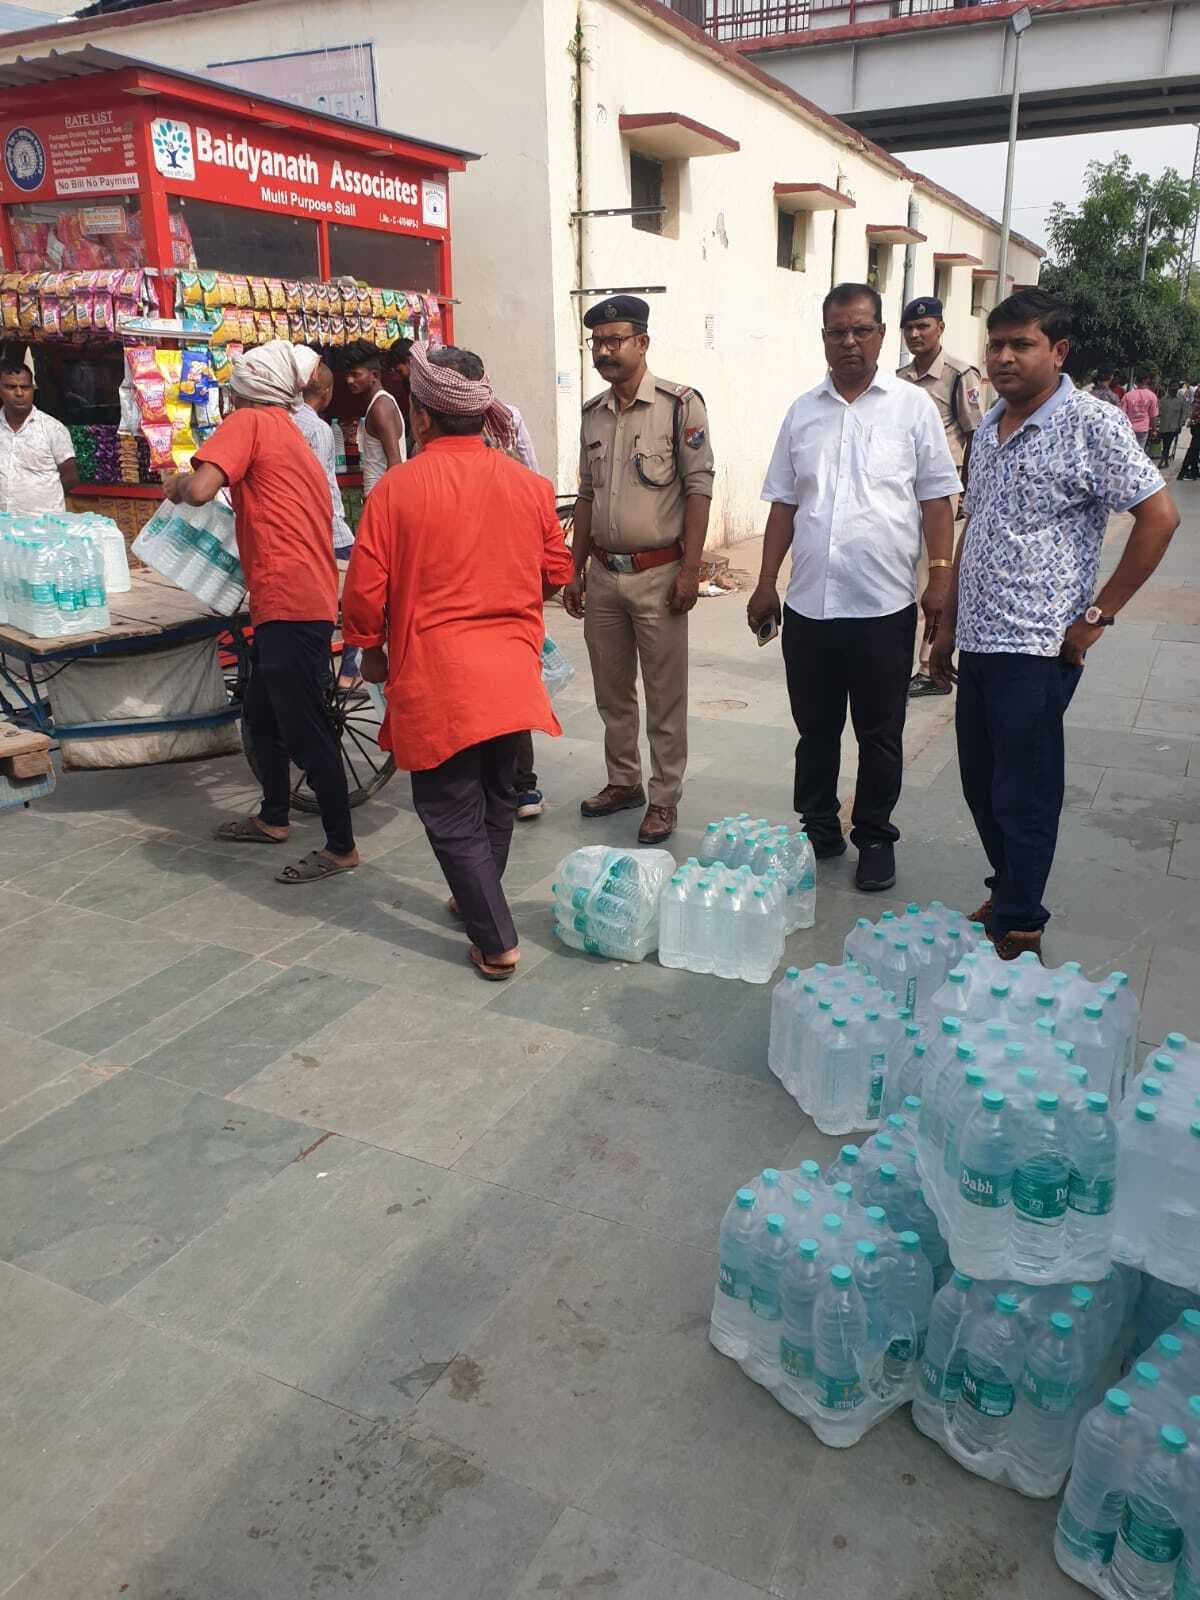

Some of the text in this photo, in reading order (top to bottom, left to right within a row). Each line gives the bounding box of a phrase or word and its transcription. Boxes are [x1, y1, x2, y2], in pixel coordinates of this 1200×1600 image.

[64, 111, 113, 126] RATE LIST
[195, 126, 418, 205] Baidyanath Associates
[58, 175, 136, 190] No Bill No Payment
[261, 187, 356, 217] Multi Purpose Stall
